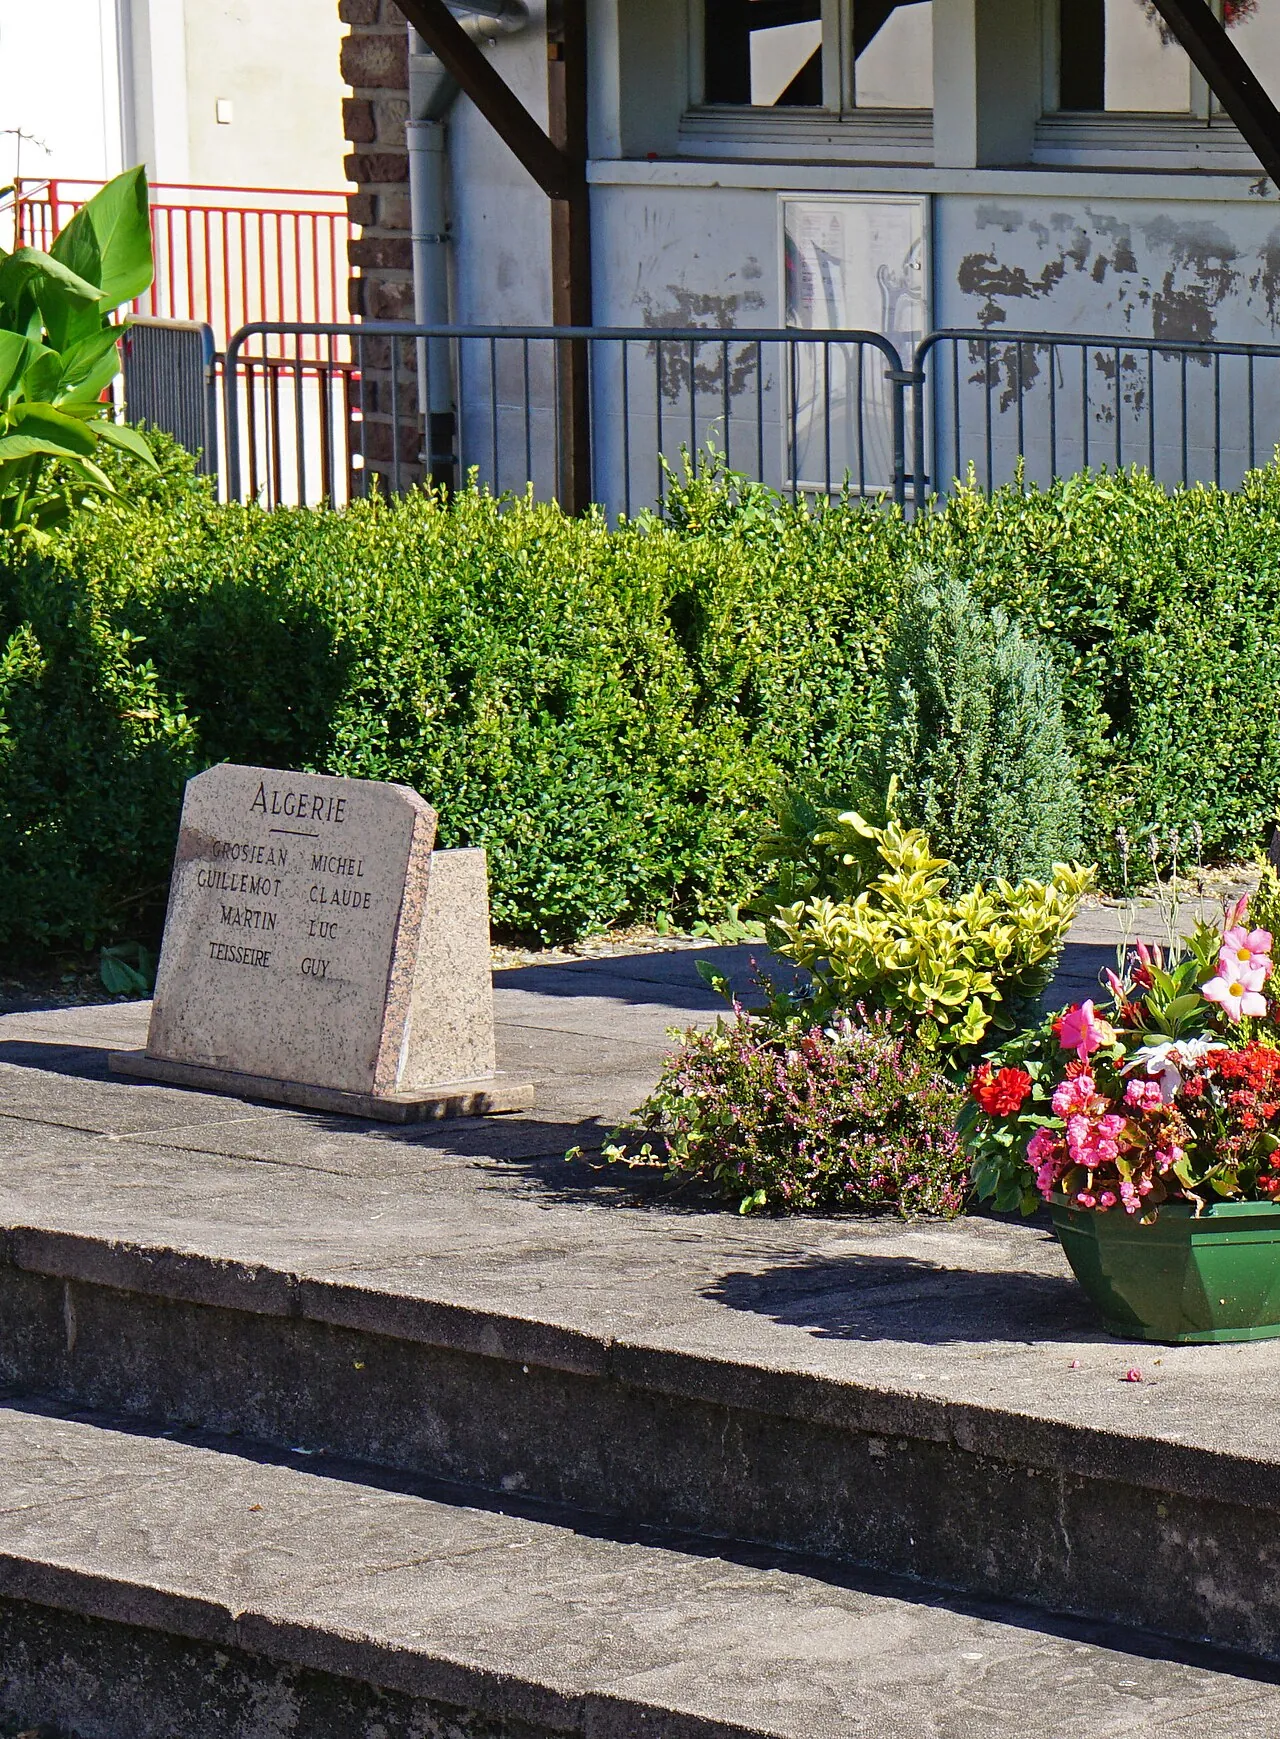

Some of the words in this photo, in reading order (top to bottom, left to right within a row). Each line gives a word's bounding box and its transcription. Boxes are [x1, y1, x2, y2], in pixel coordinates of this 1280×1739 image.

[250, 781, 347, 824] ALGERIE
[212, 840, 288, 867] GROSJEAN
[311, 854, 364, 878] MICHEL
[198, 870, 281, 897] GUILLEMOT
[310, 885, 371, 910] CLAUDE
[221, 905, 277, 931] MARTIN
[309, 919, 338, 940] LUC
[209, 942, 271, 968] TEISSEIRE
[301, 957, 330, 978] GUY
